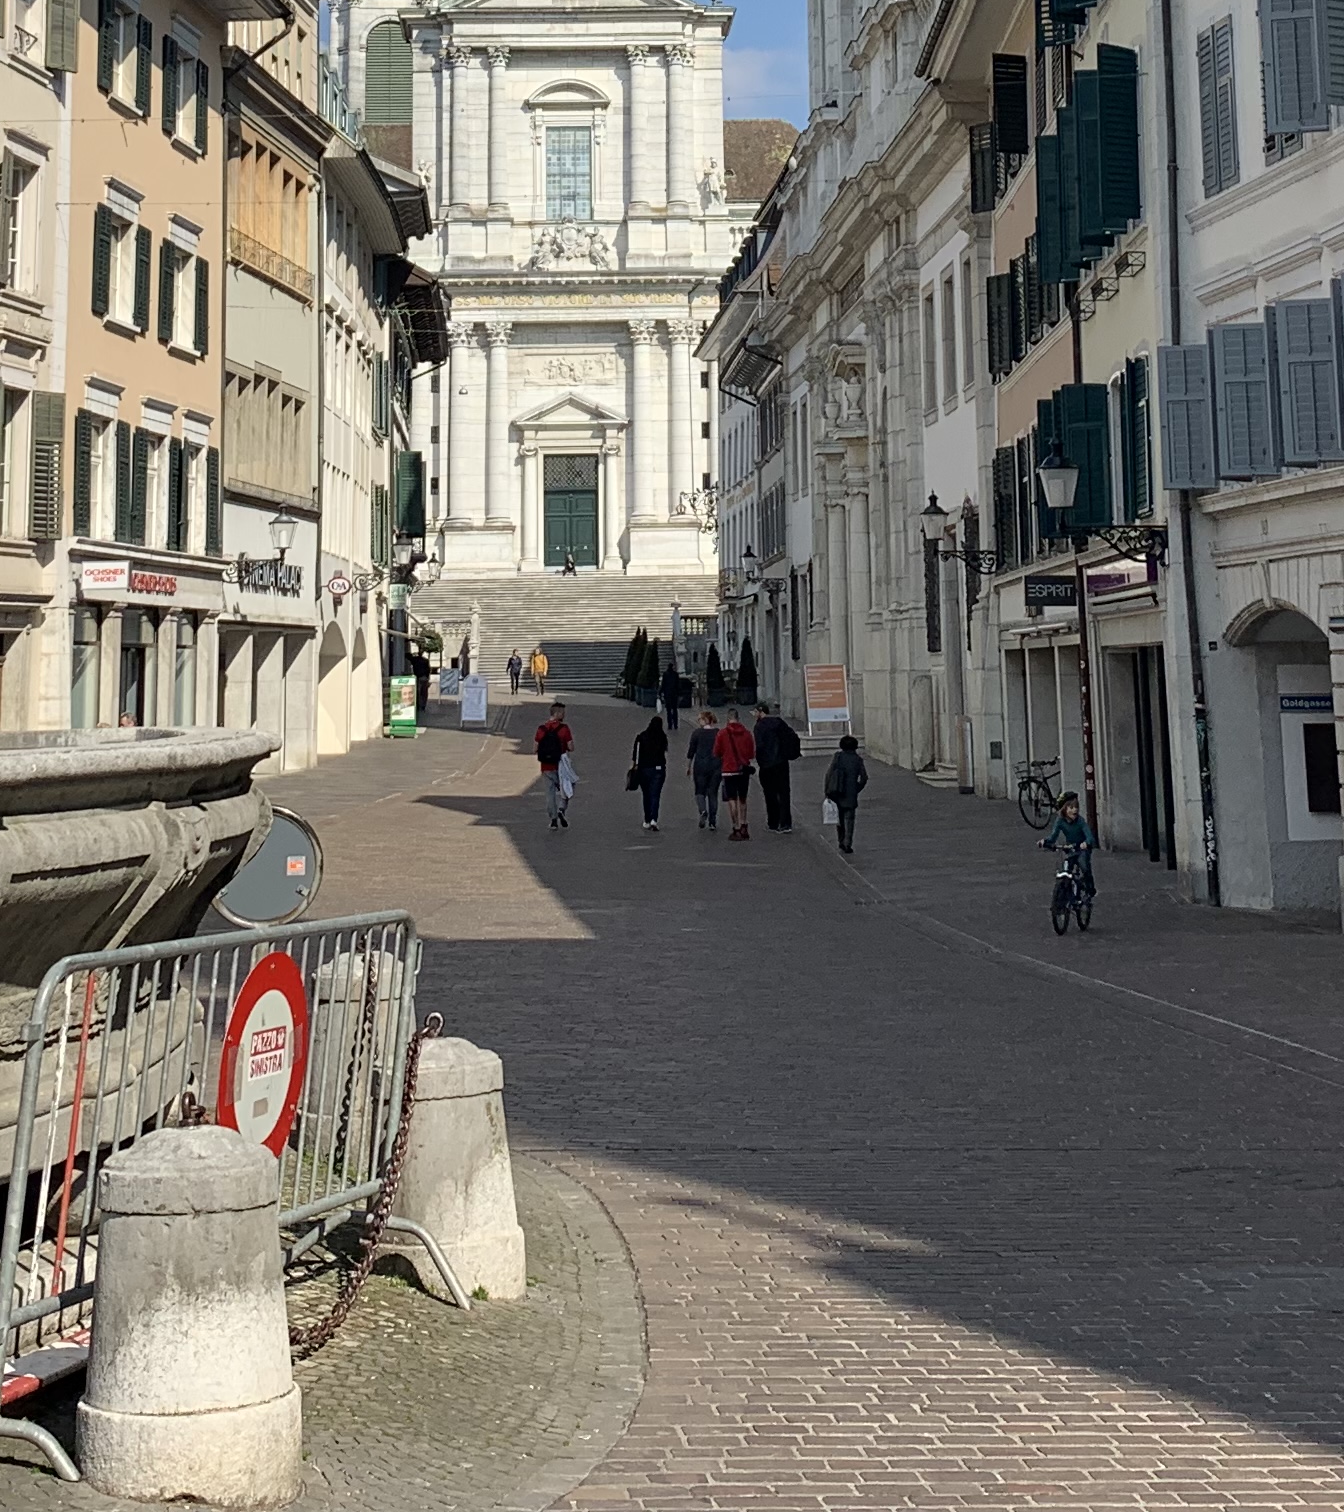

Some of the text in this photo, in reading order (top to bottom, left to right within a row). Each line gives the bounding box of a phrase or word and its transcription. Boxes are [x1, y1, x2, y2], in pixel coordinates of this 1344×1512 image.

[85, 568, 125, 576] OCHSNER
[93, 575, 117, 583] SHOES
[1027, 584, 1073, 597] ESPRIT
[1282, 698, 1332, 708] Goldgasse
[250, 1030, 277, 1055] PAZZO
[249, 1053, 282, 1078] SINISTRA
